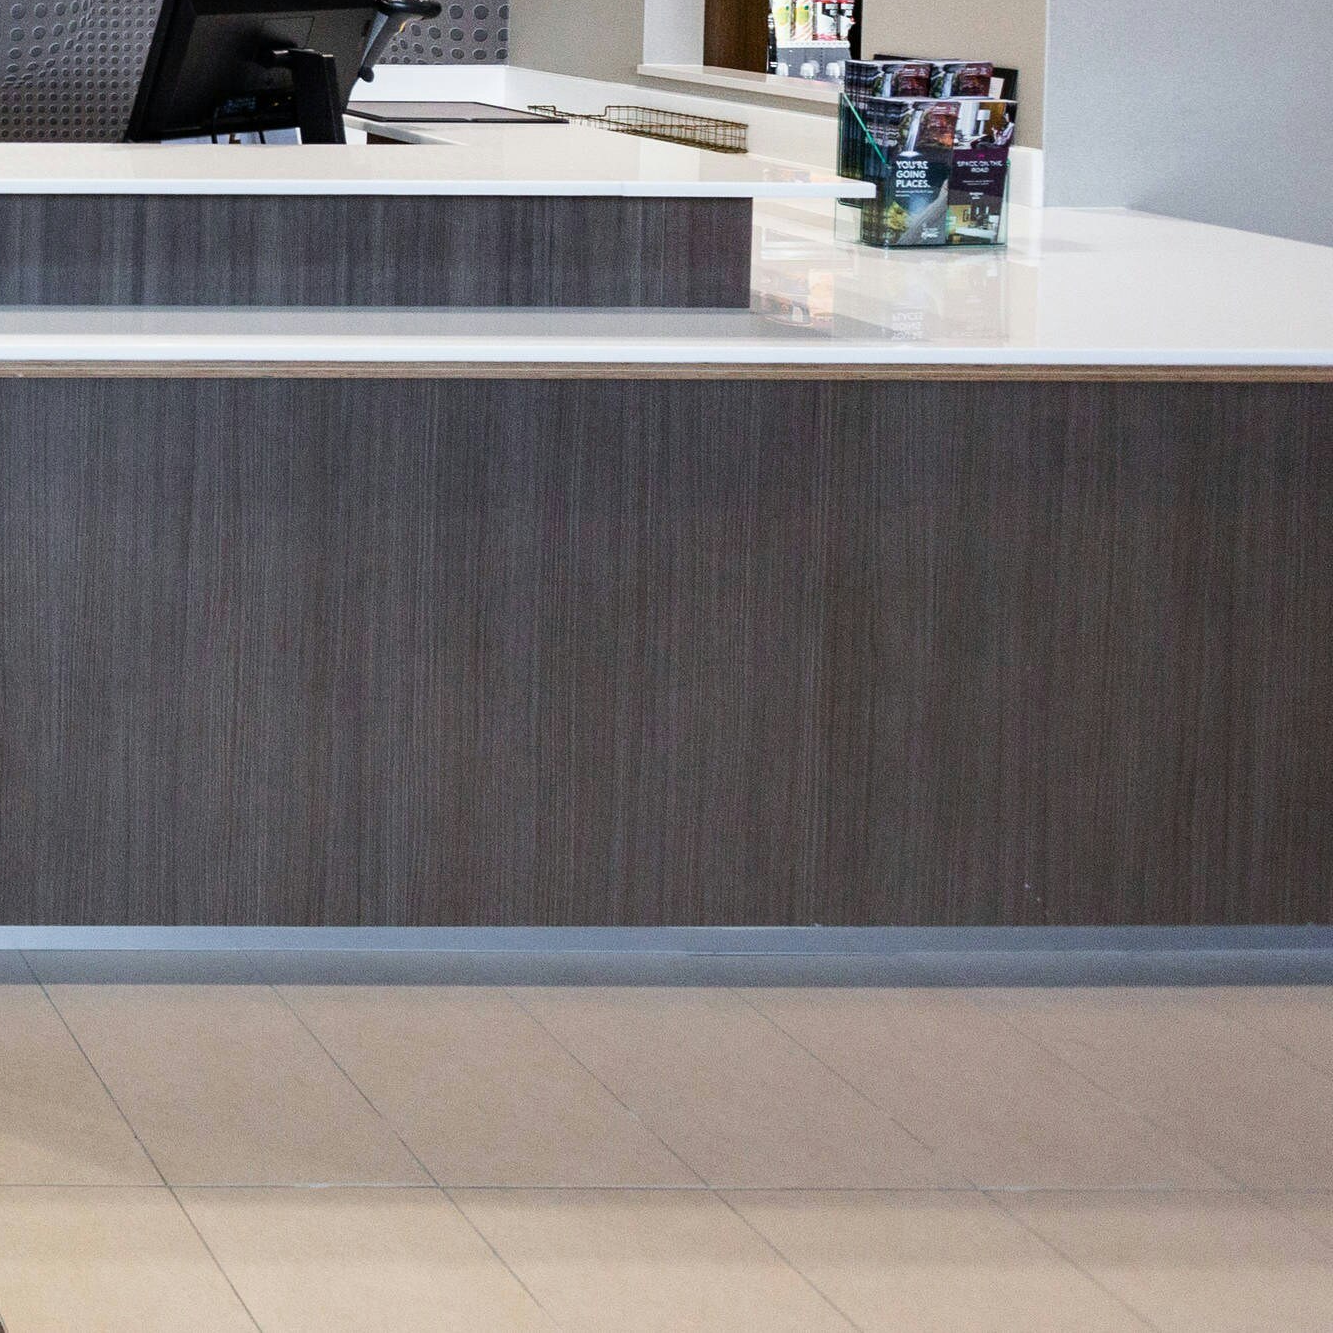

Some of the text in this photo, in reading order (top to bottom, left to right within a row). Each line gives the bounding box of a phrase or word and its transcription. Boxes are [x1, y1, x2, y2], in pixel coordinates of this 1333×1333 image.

[895, 160, 929, 170] YOU'RE
[895, 170, 927, 179] GOING
[895, 179, 931, 188] PLACES.
